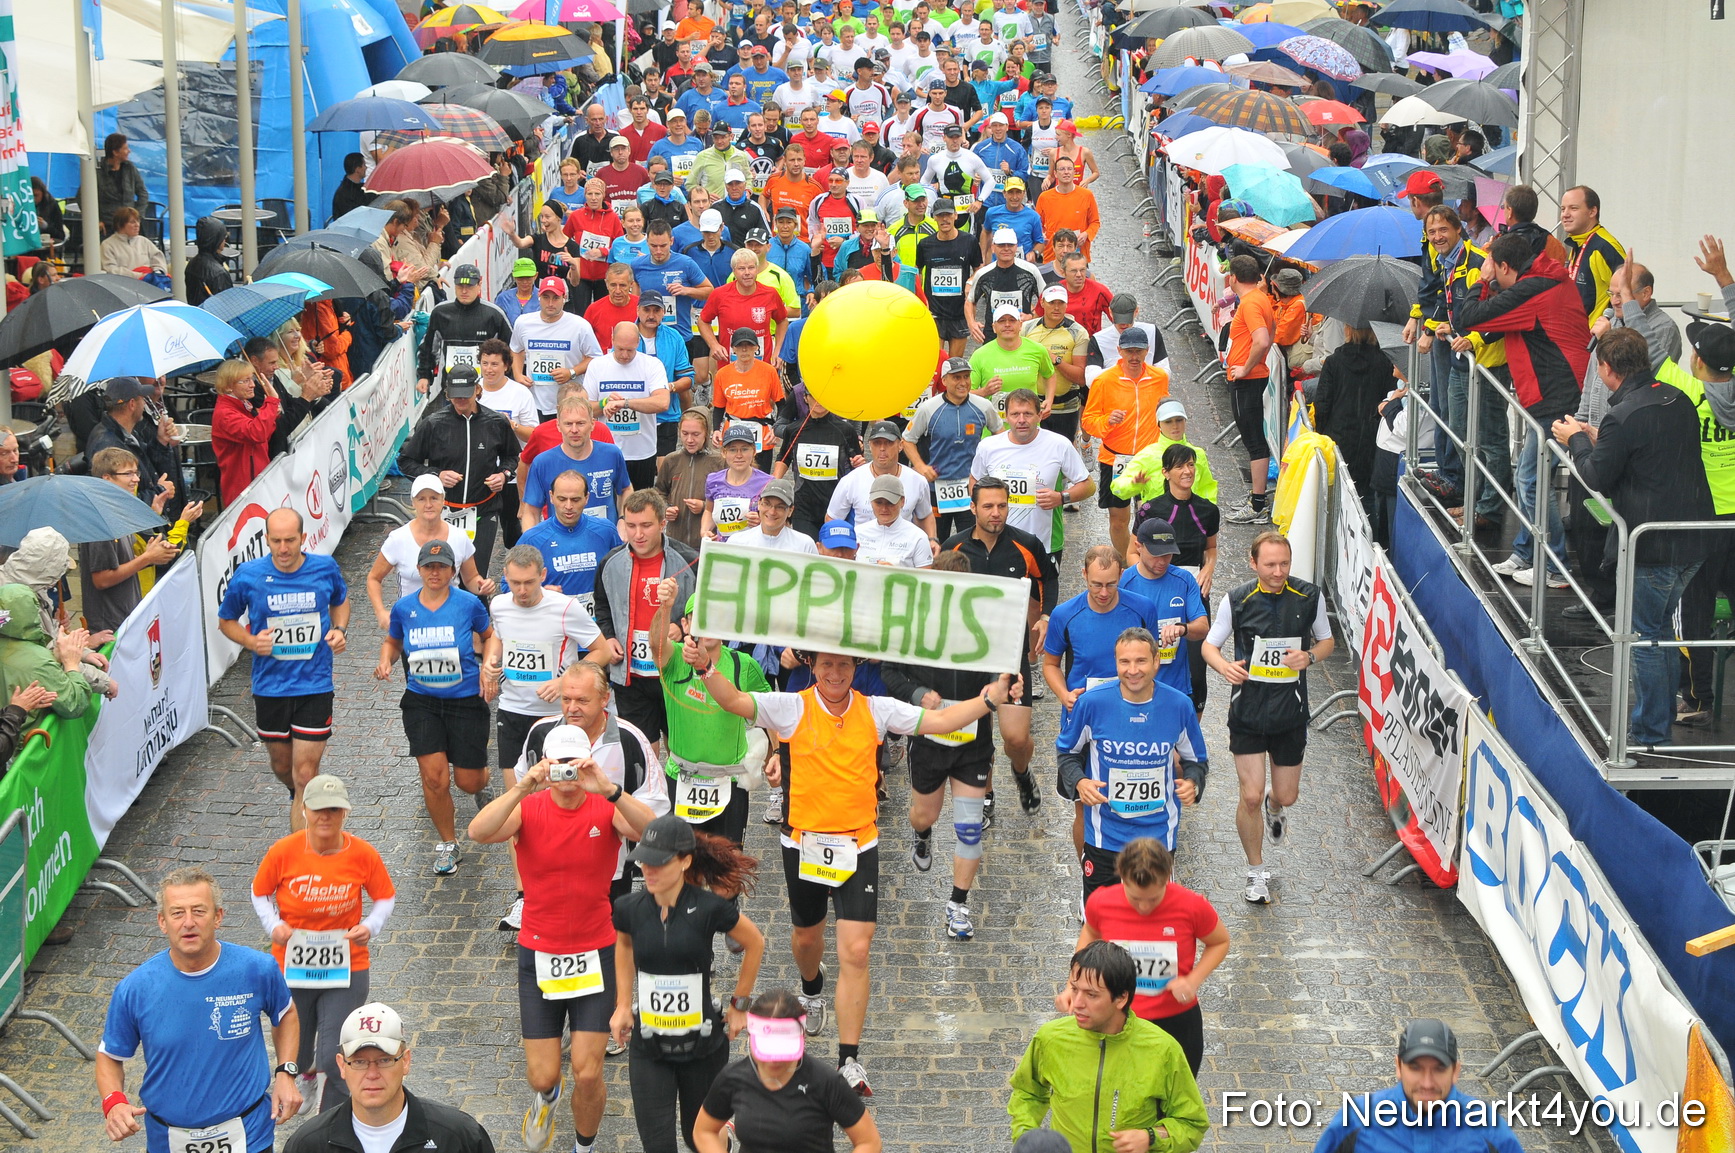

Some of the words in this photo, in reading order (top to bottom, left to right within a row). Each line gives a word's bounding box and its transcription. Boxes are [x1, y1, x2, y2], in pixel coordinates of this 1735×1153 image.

[826, 225, 850, 235] 2983
[933, 276, 958, 286] 2291
[533, 341, 568, 350] STAEDTLER
[605, 383, 642, 391] STAEDTLER
[730, 387, 760, 396] Fischer
[805, 454, 830, 468] 574
[809, 469, 825, 477] Birgit
[1006, 479, 1028, 495] 30
[719, 507, 743, 523] 432
[552, 551, 597, 567] HUBER
[267, 591, 316, 606] HUBER
[698, 552, 1004, 663] APPLAUS
[274, 627, 316, 644] 2167
[409, 626, 455, 641] HUBER
[280, 646, 313, 655] Willibald
[414, 661, 456, 674] 2175
[507, 651, 546, 670] 2231
[515, 671, 537, 680] Stefan
[1265, 668, 1284, 677] Peter
[1102, 739, 1171, 757] SYSCAD
[686, 787, 720, 806] 494
[1114, 781, 1162, 801] 2796
[1124, 803, 1150, 812] Robert
[823, 847, 834, 866] 9
[816, 867, 837, 879] Bernd
[298, 881, 353, 897] Fischer
[291, 945, 345, 967] 3285
[550, 953, 588, 978] 825
[214, 999, 248, 1008] STADTLAUF
[215, 992, 254, 1003] NEUMARKTER
[650, 990, 690, 1013] 628
[359, 1016, 382, 1033] KU
[654, 1016, 687, 1028] Claudia
[185, 1137, 232, 1153] 625
